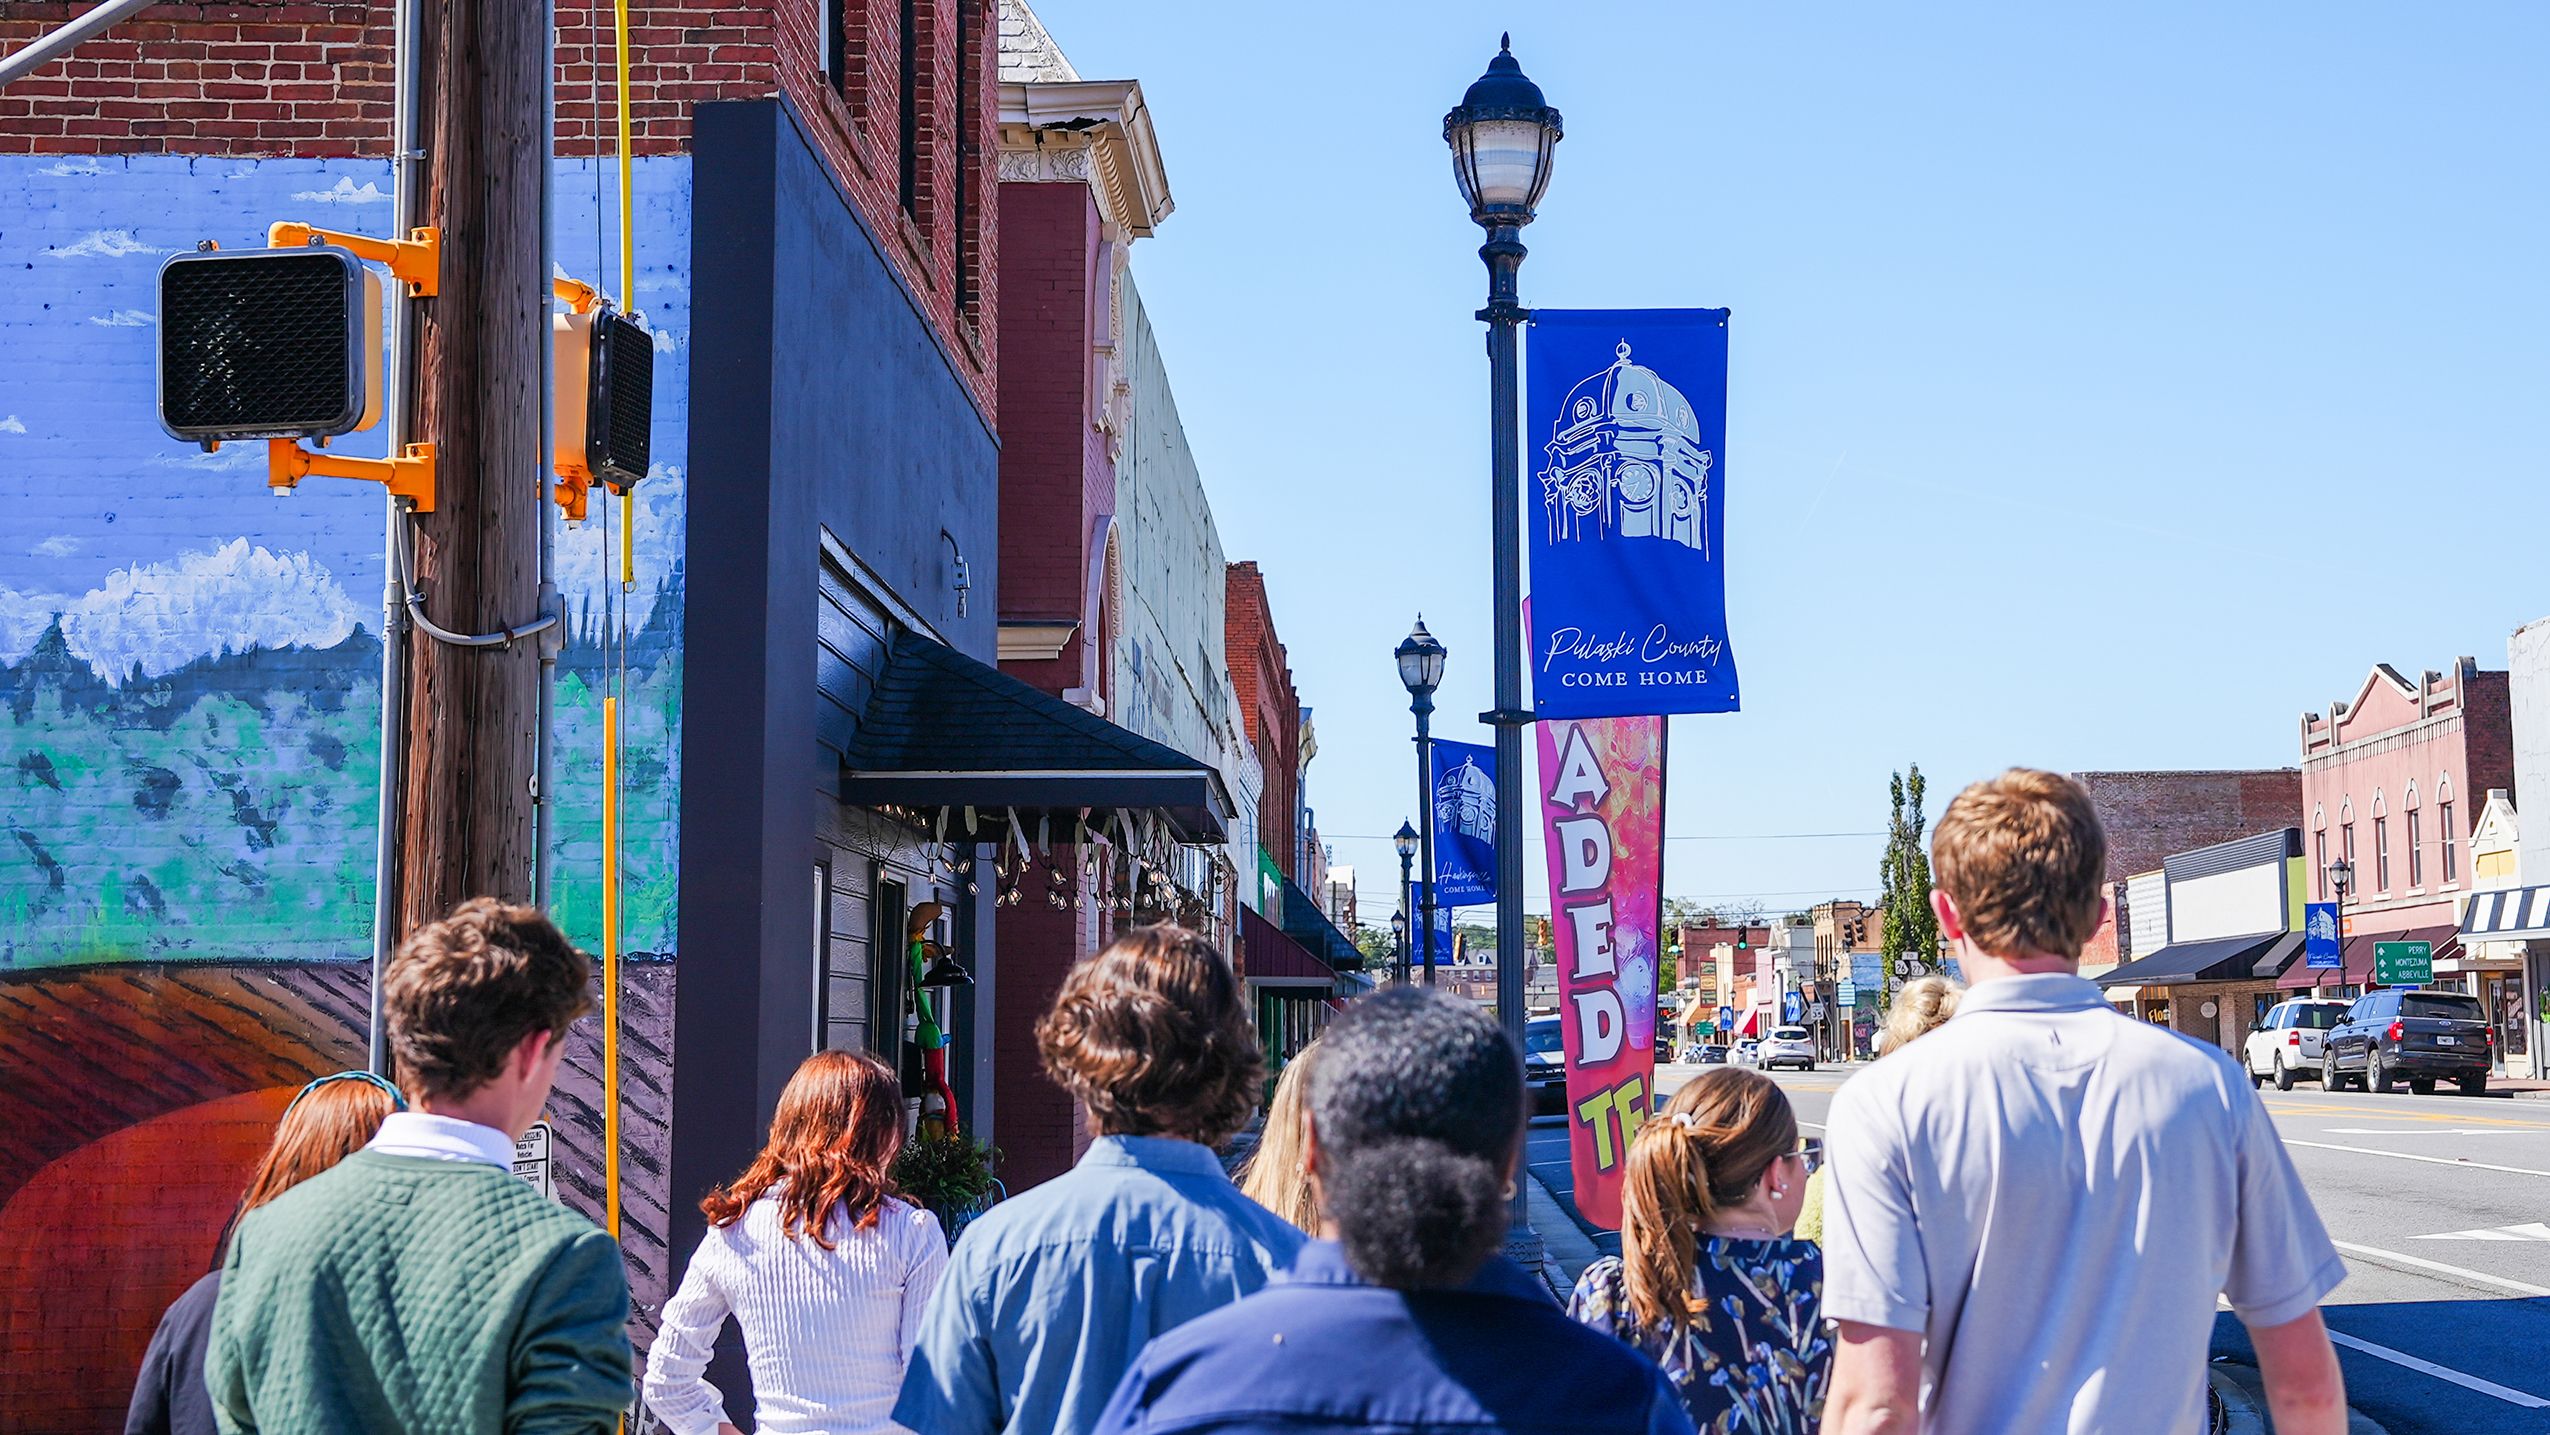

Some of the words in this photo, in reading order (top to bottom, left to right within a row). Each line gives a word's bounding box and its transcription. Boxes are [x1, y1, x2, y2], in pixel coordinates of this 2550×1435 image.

[1543, 627, 1635, 673] Pulaski
[1641, 623, 1723, 667] County
[1561, 672, 1628, 687] COME
[1639, 670, 1708, 686] HOME
[1443, 886, 1465, 894] COME
[1549, 724, 1624, 1067] ADED
[2408, 945, 2427, 955] PERRY
[2395, 958, 2428, 967] MONTEZUMA
[1896, 964, 1906, 973] 26
[1912, 965, 1921, 976] 27
[2398, 970, 2429, 979] ABBEVILLE
[1812, 1010, 1823, 1018] 35
[2148, 1008, 2164, 1024] Flo
